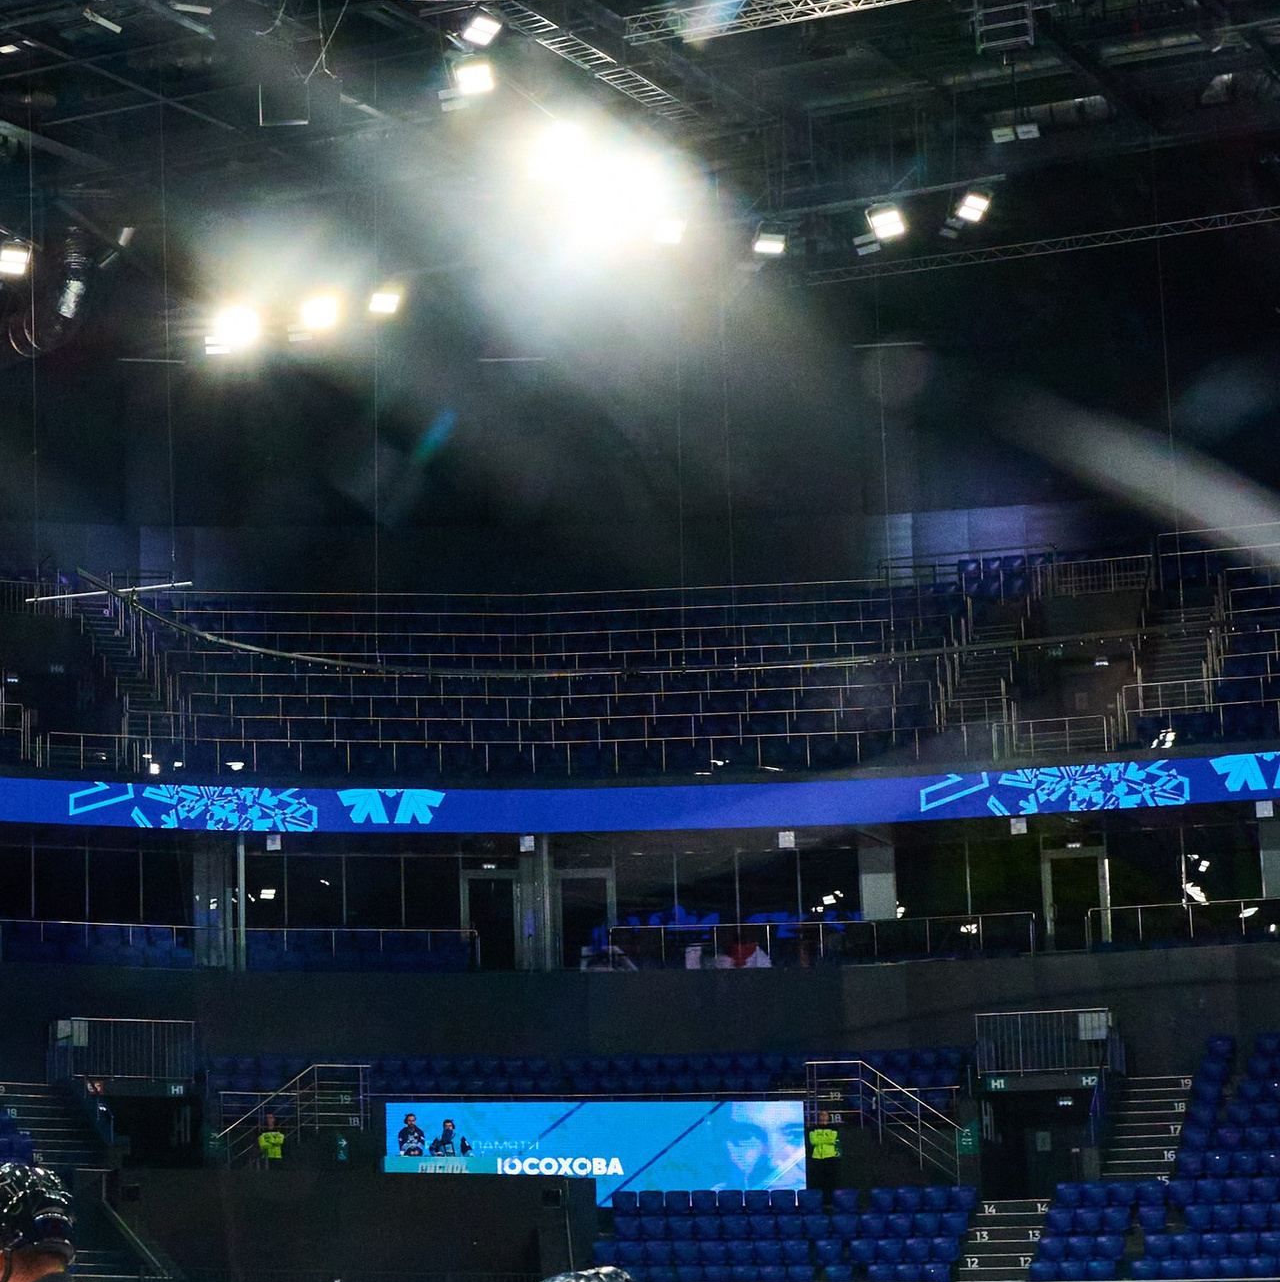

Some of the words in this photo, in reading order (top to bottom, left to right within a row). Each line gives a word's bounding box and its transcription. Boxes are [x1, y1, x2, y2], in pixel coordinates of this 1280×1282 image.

[990, 1079, 1005, 1089] H1
[1082, 1076, 1098, 1087] H2
[1180, 1078, 1193, 1089] 19
[1173, 1102, 1186, 1113] 18
[1169, 1125, 1182, 1135] 17
[1163, 1150, 1176, 1161] 16
[983, 1204, 996, 1215] 14
[1036, 1202, 1049, 1213] 14
[976, 1231, 989, 1242] 13
[1028, 1230, 1041, 1241] 13
[966, 1257, 979, 1268] 12
[1019, 1257, 1033, 1268] 12
